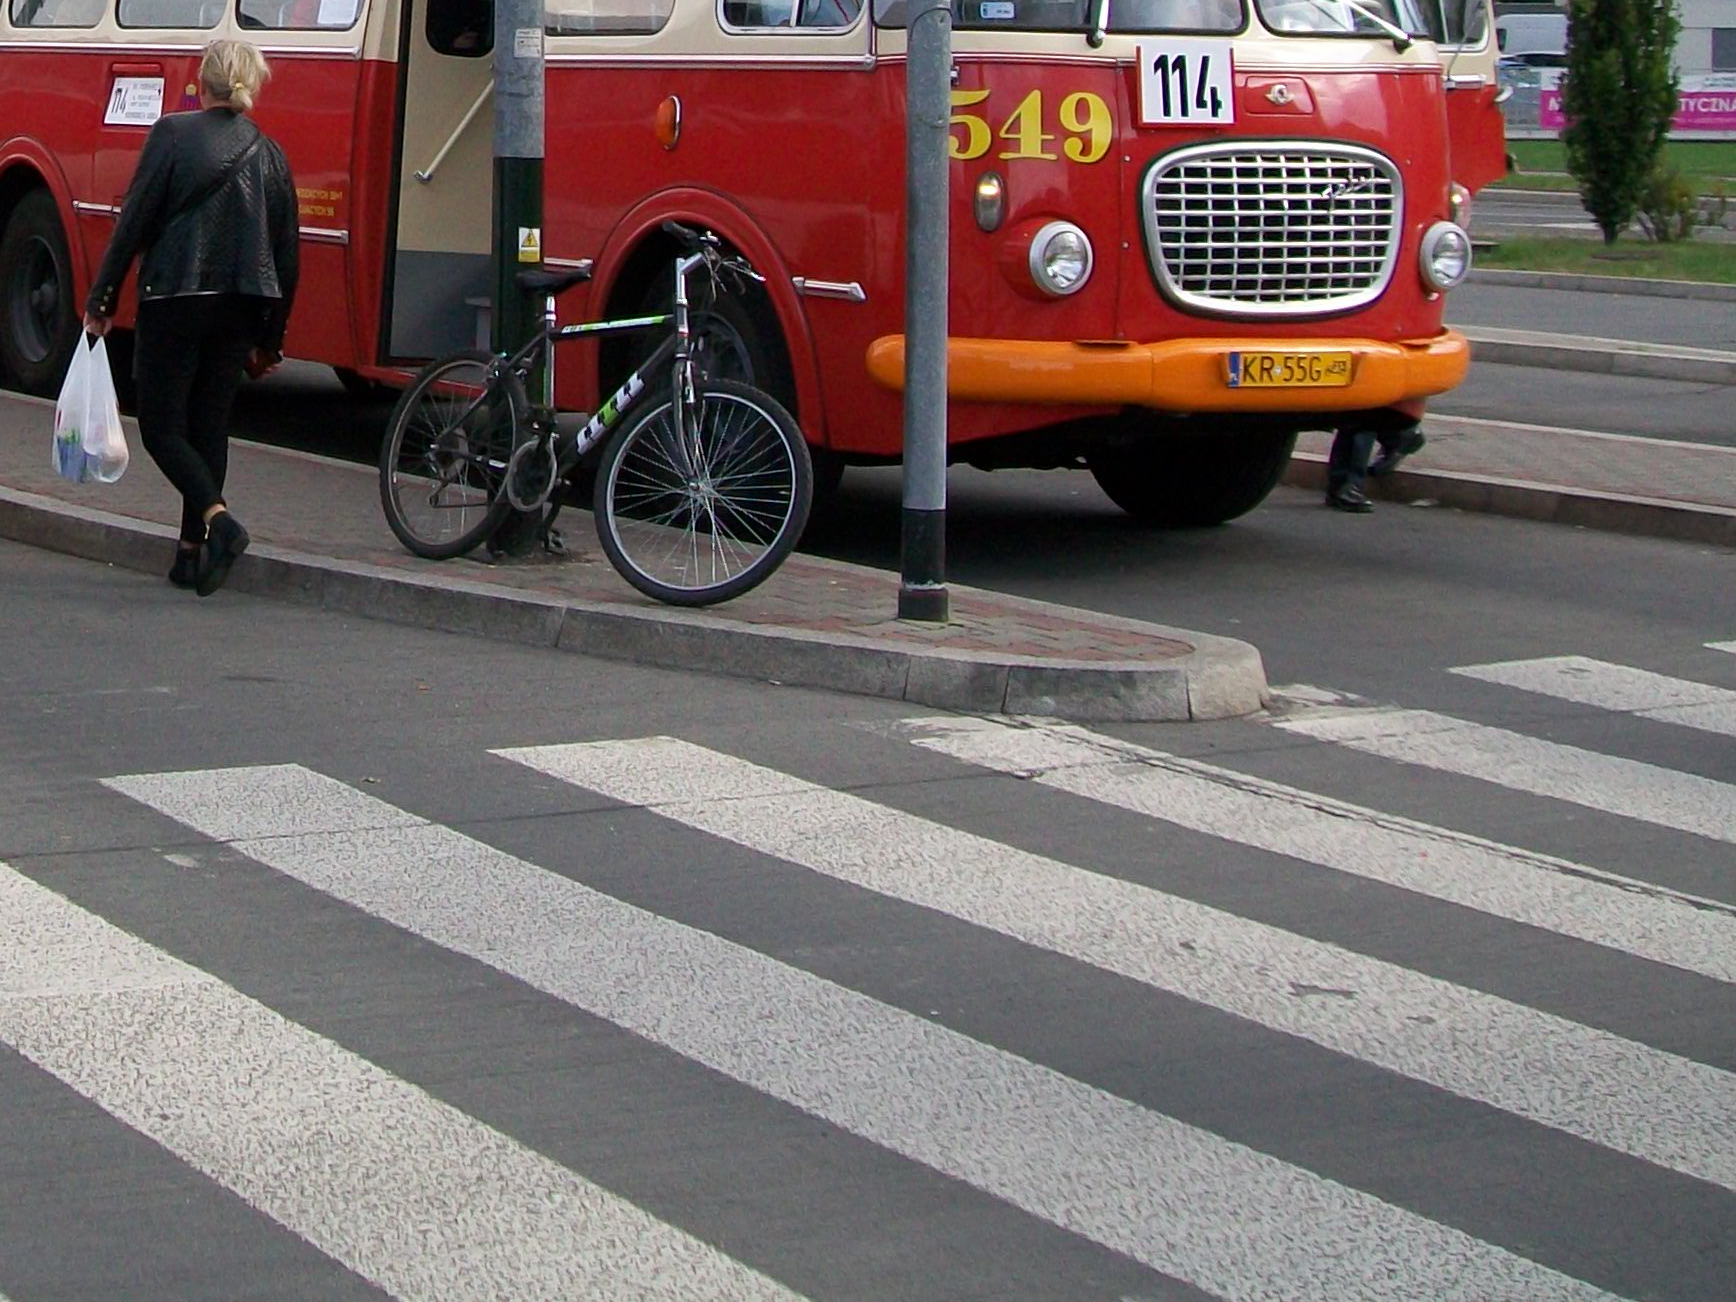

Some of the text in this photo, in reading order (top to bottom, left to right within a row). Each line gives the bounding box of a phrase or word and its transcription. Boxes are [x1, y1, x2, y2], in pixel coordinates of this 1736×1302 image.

[1153, 53, 1223, 118] 114
[949, 89, 1113, 163] 549
[1243, 355, 1322, 383] KR 55G
